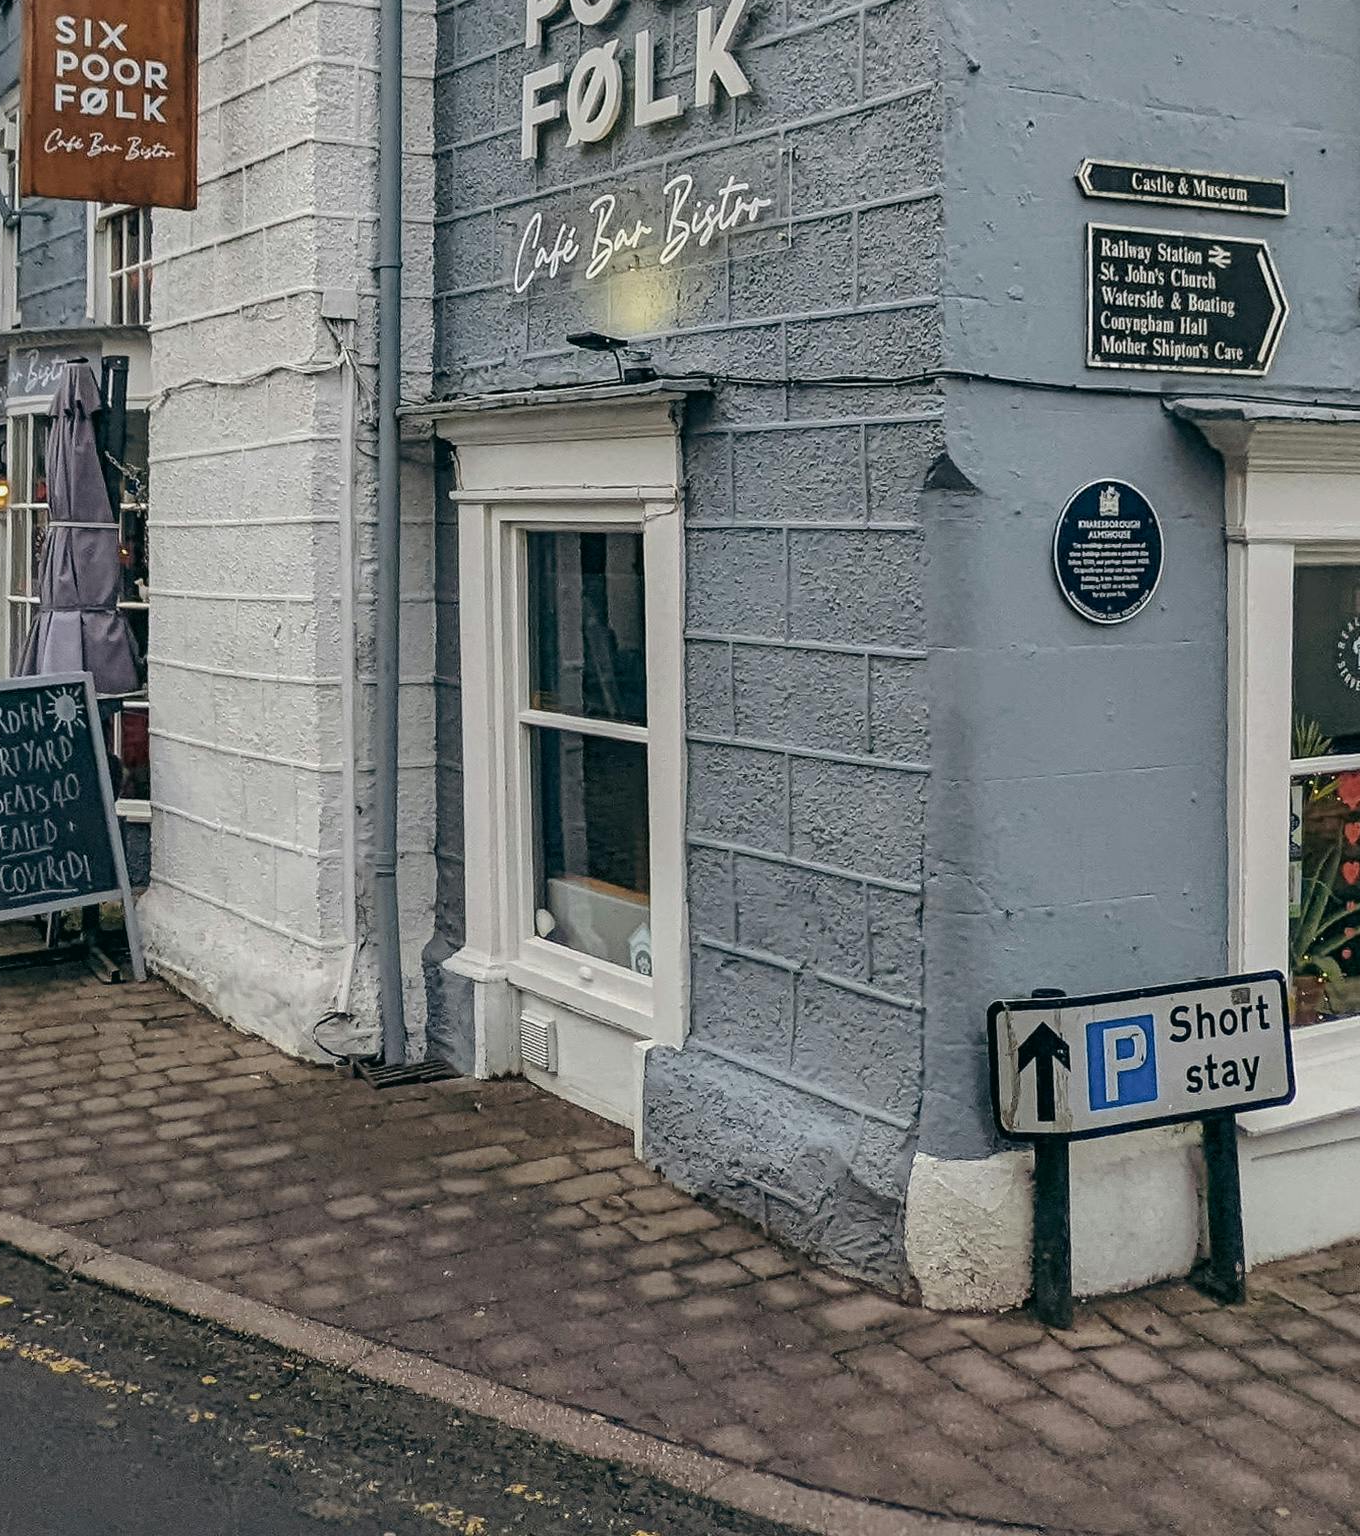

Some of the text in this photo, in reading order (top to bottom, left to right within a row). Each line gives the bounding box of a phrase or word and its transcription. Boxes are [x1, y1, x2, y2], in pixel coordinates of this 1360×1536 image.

[55, 15, 128, 52] SIX
[55, 49, 168, 91] POOR
[54, 83, 168, 123] FØLK
[87, 132, 122, 157] Bar
[125, 136, 176, 161] Bistro
[1132, 172, 1248, 202] Castle & Museum
[513, 174, 772, 295] Café Bar Bistro
[1100, 237, 1202, 265] Railway Station
[1100, 262, 1216, 290] St. John's Church
[1101, 286, 1235, 318] Waterside & Boating
[1100, 312, 1208, 336] Conyngham Hall
[1101, 335, 1244, 361] Mother Shipton's Cave
[52, 773, 80, 808] 40
[0, 851, 91, 894] COVERED!
[1169, 995, 1271, 1043] Short
[1103, 1025, 1147, 1102] P
[1185, 1054, 1261, 1093] stay
